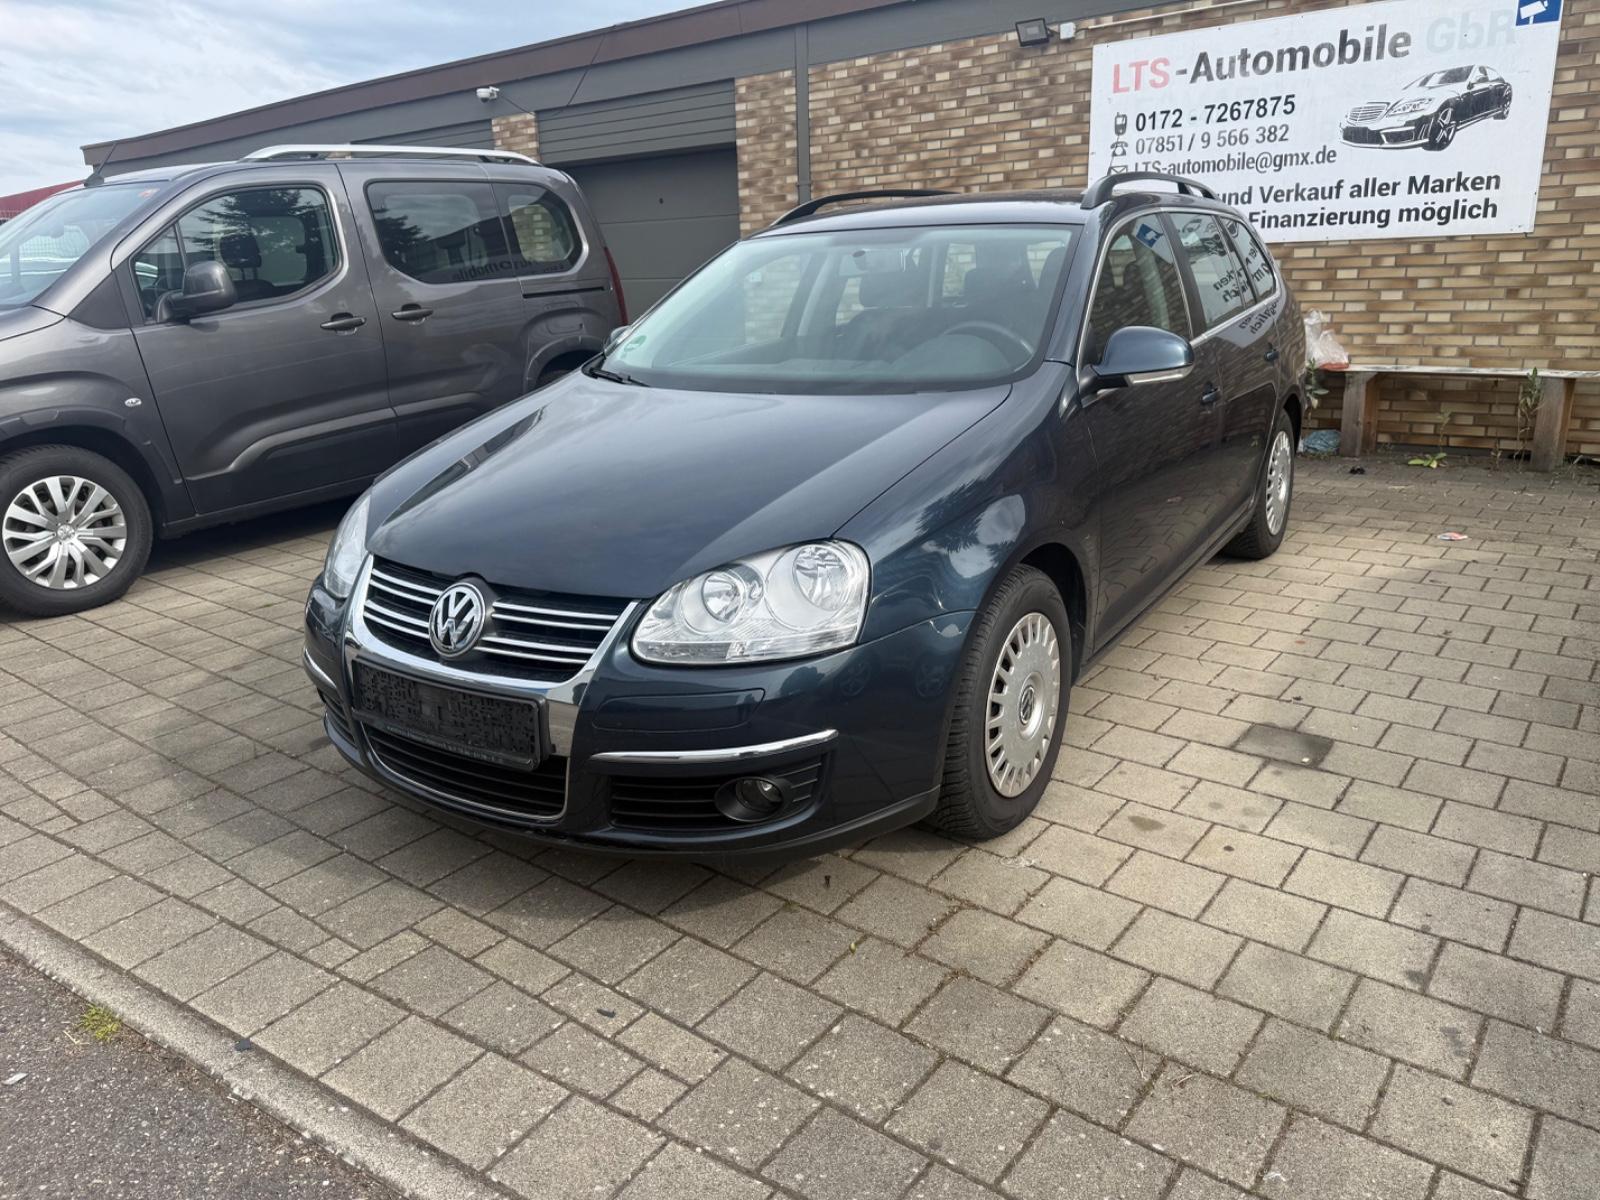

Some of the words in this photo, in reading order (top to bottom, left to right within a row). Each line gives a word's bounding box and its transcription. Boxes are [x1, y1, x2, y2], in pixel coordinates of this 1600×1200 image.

[1112, 24, 1411, 94] LTS-Automobile
[1426, 9, 1516, 53] GbR
[1136, 108, 1183, 131] 0172
[1204, 94, 1296, 124] 7267875
[1201, 131, 1211, 149] 9
[1217, 128, 1249, 148] 566
[1255, 123, 1290, 144] 382
[1259, 179, 1344, 204] Verkauf
[1349, 177, 1401, 199] aller
[1407, 171, 1501, 195] Marken
[1249, 207, 1390, 229] Finanzierung
[1397, 197, 1498, 226] möglich
[431, 583, 483, 654] VW
